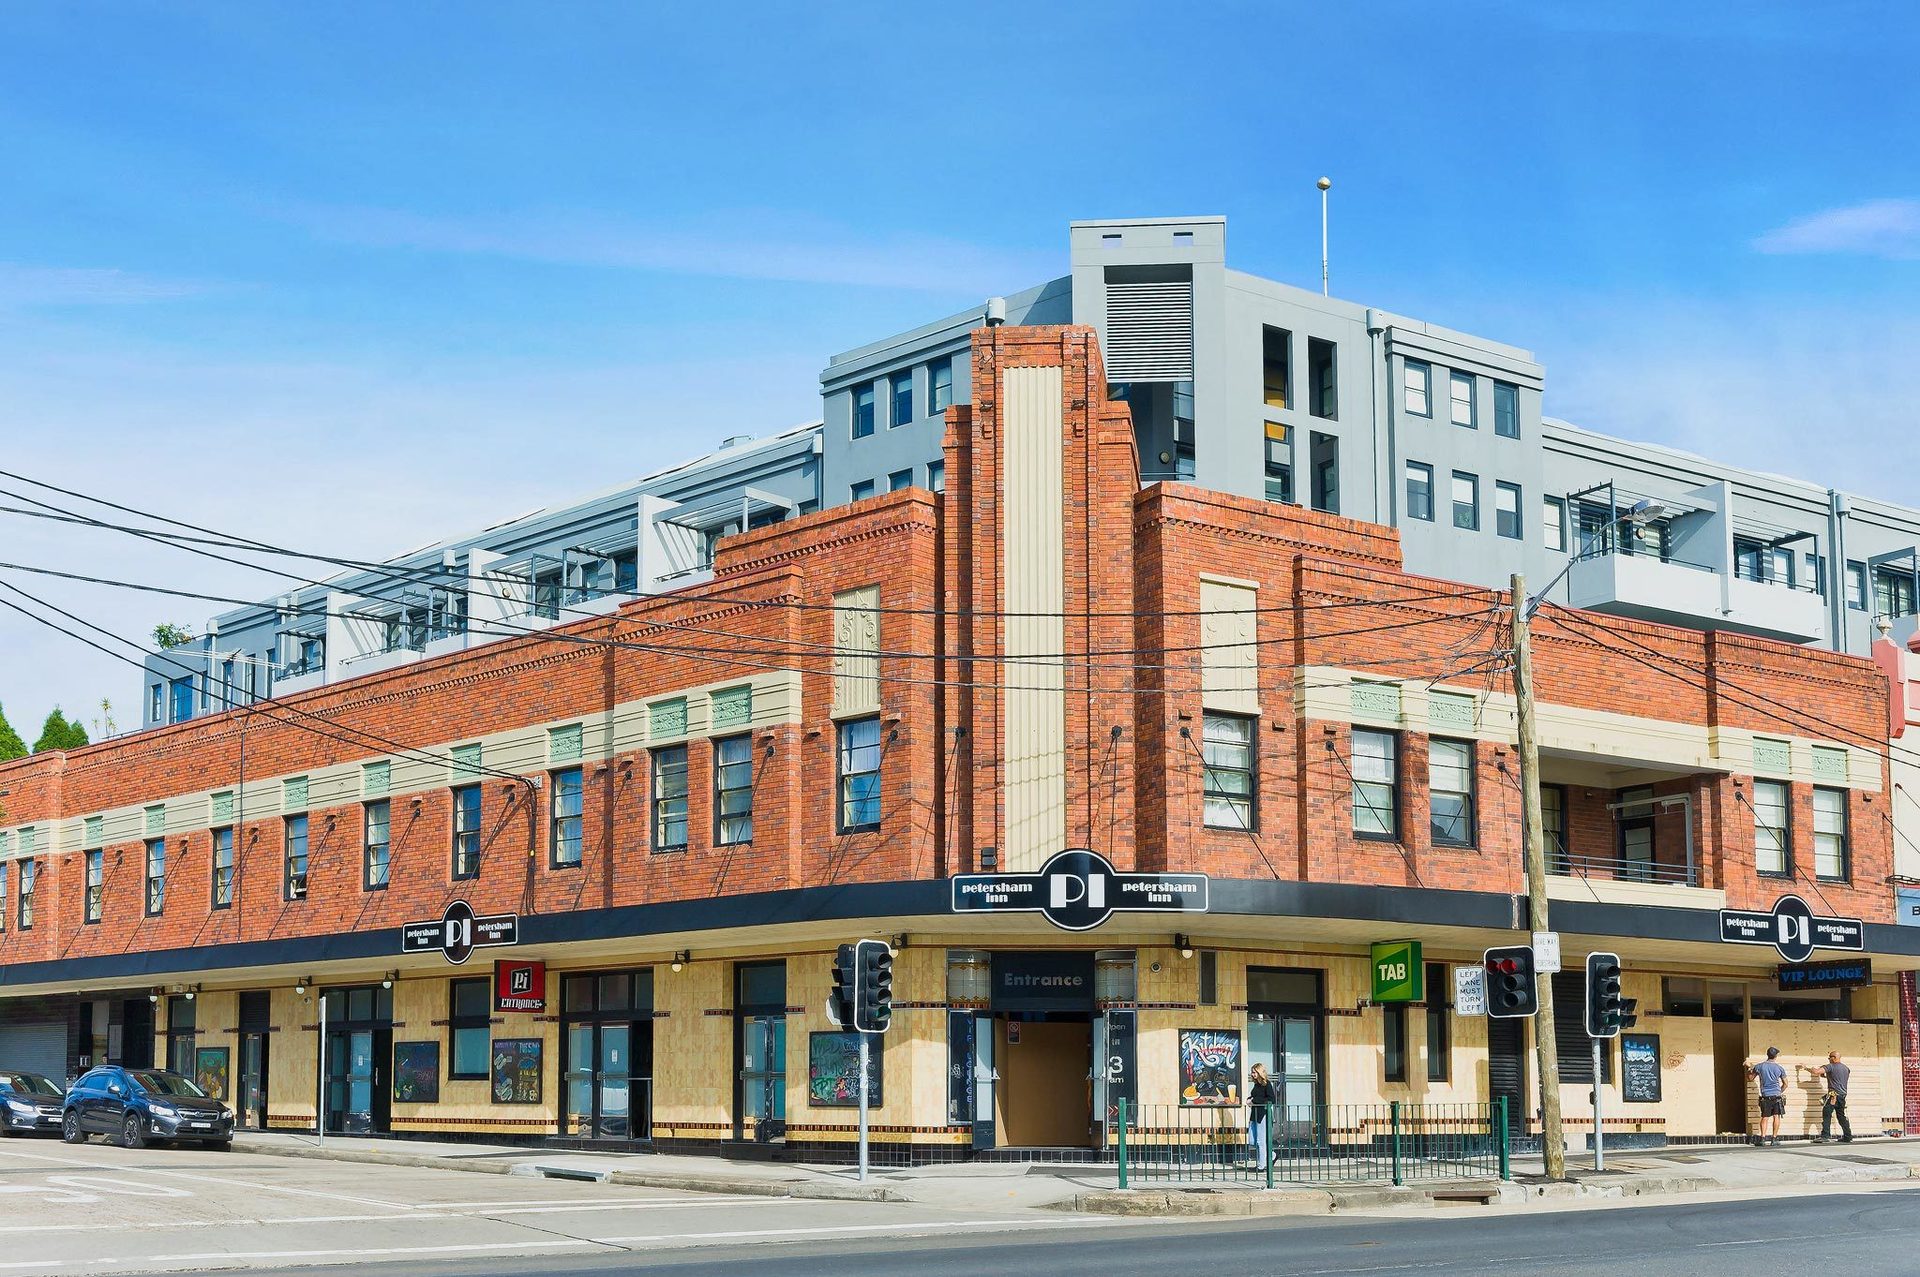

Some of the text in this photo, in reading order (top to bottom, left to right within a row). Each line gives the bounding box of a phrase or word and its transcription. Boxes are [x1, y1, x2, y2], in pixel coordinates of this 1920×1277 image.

[962, 882, 1032, 894] petersham
[1122, 881, 1197, 893] petersham
[985, 892, 1008, 903] inn
[1148, 891, 1171, 902] inn
[478, 922, 512, 932] petersham
[1726, 918, 1769, 929] petersham
[1817, 924, 1857, 935] petersham
[408, 929, 439, 938] petersham
[1378, 963, 1406, 981] TAB
[1782, 966, 1865, 983] VIP LOUNGE
[1004, 973, 1083, 986] Entrance
[1181, 1032, 1237, 1069] Kitchen
[1109, 1055, 1124, 1074] 3
